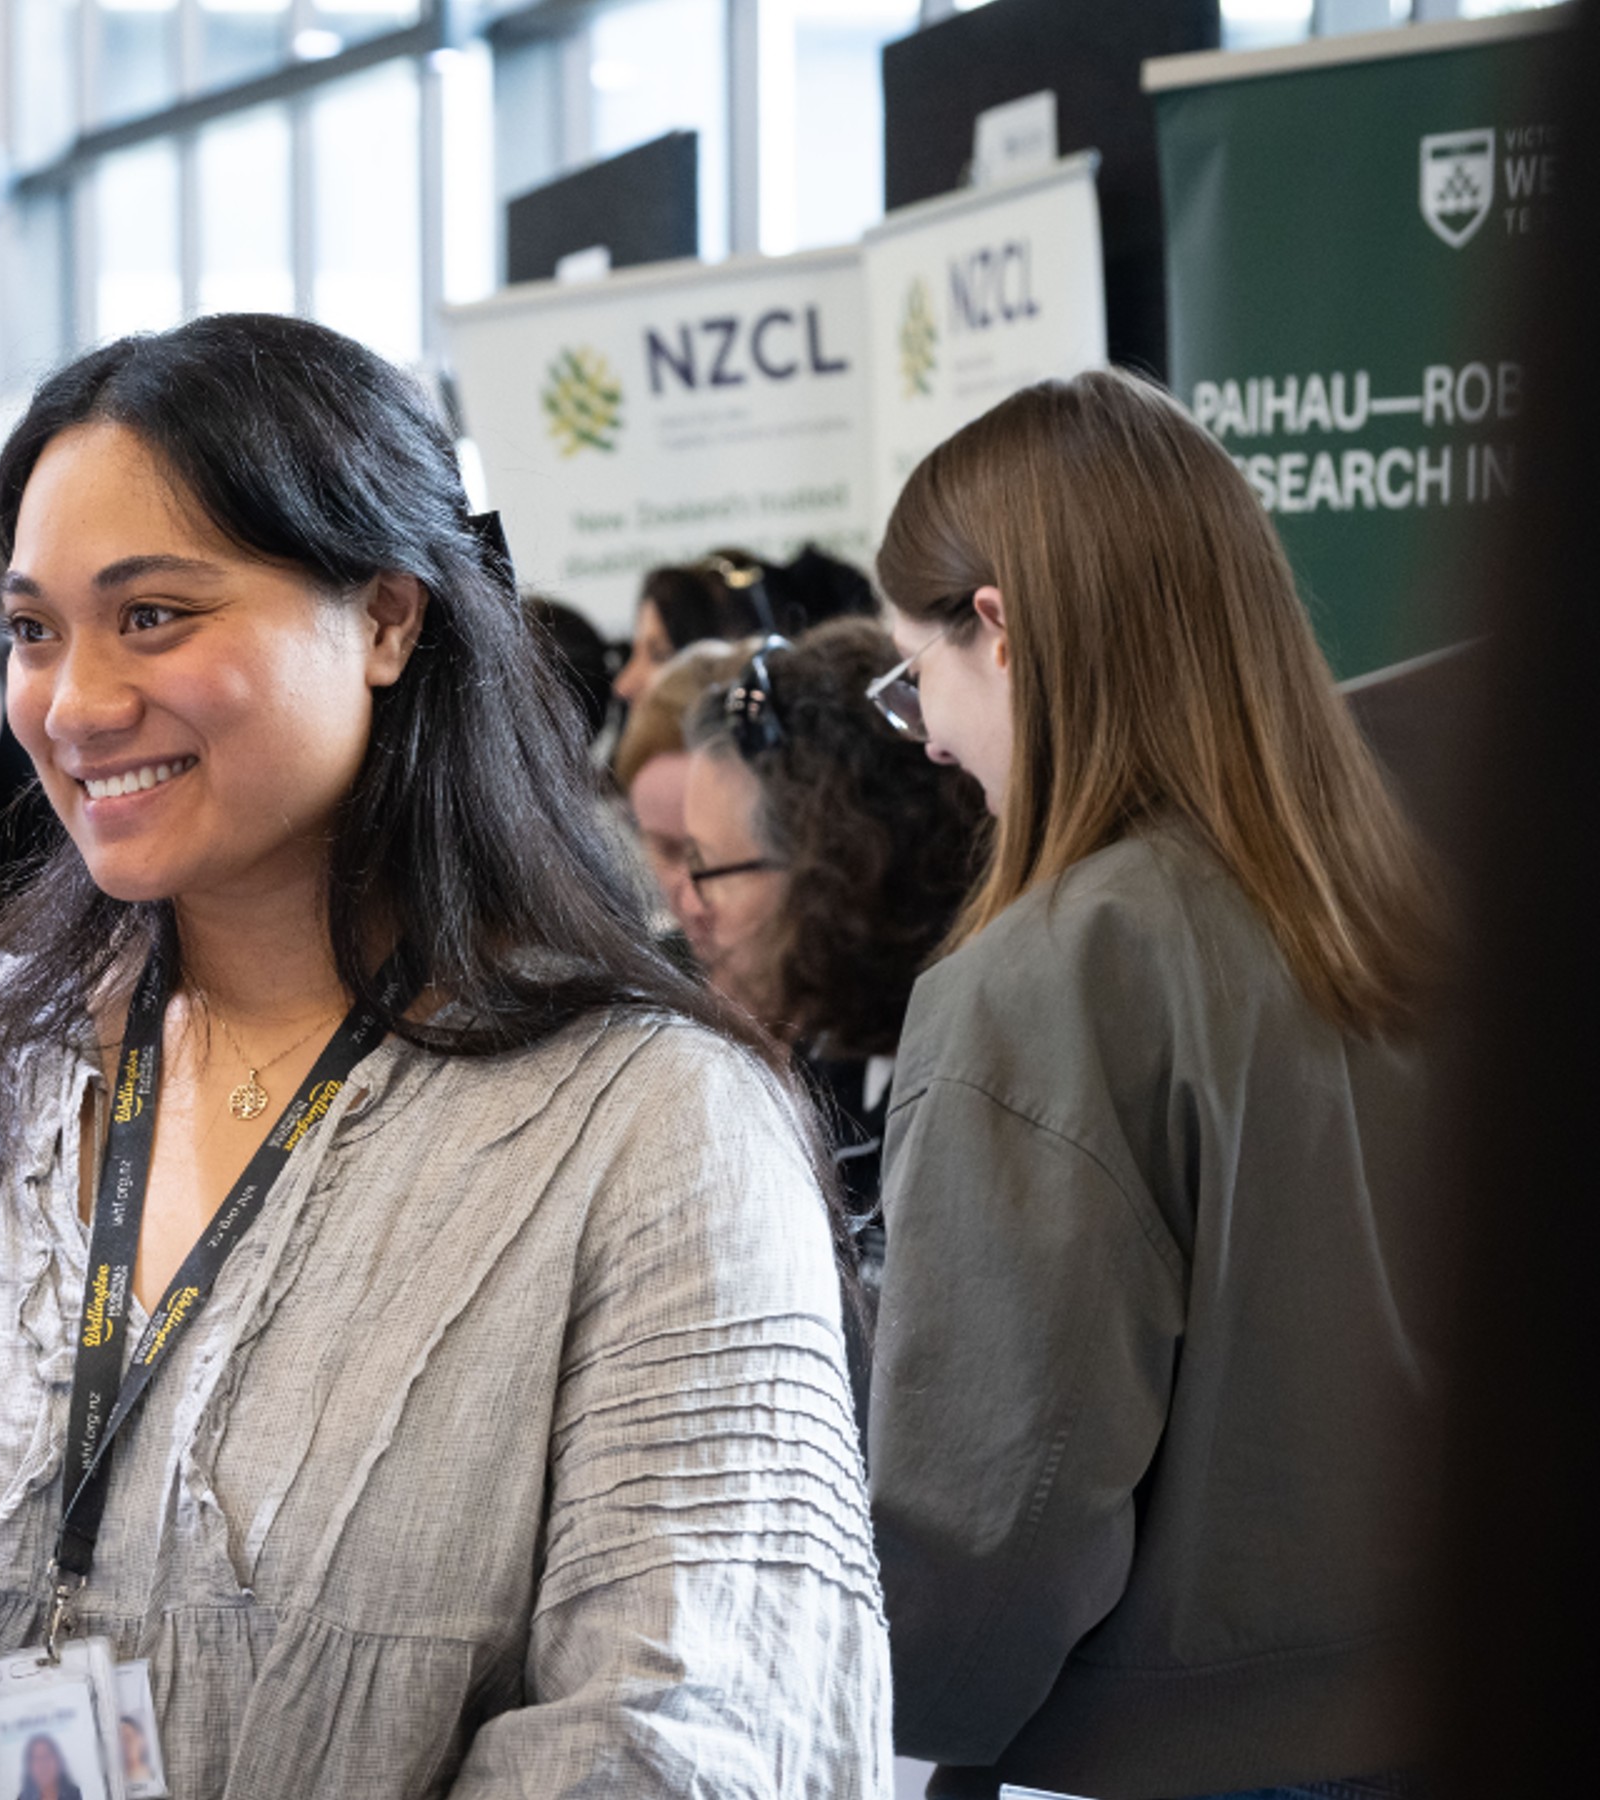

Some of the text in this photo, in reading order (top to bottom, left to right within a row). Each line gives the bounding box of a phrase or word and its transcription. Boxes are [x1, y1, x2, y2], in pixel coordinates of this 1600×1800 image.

[947, 236, 1041, 334] NZCL
[642, 303, 850, 394] NZCL
[1229, 446, 1453, 513] SEARCH
[82, 1263, 111, 1348] Wellington
[144, 1285, 200, 1366] Wellington
